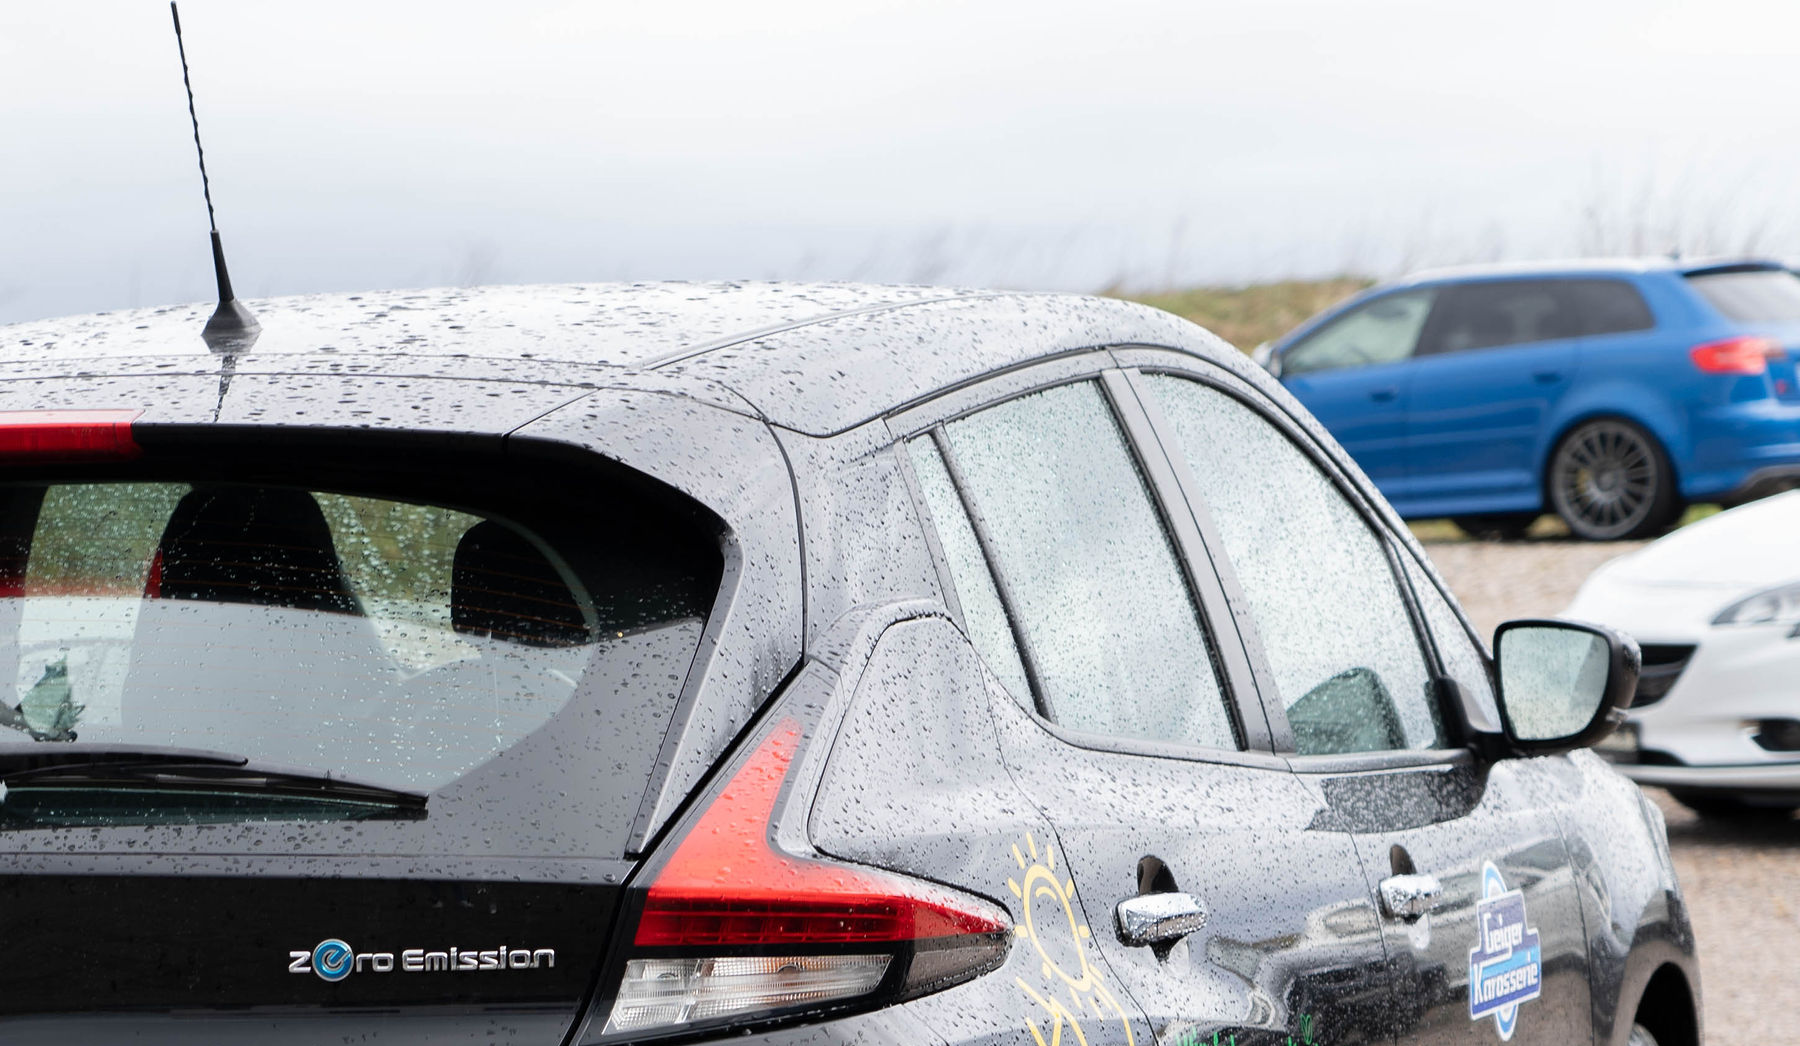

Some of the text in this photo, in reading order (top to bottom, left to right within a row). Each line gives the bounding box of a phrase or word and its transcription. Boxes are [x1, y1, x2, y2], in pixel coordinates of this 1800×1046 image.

[1483, 911, 1524, 957] Geiger
[402, 945, 555, 972] Emission
[1473, 951, 1539, 1005] Karosserie
